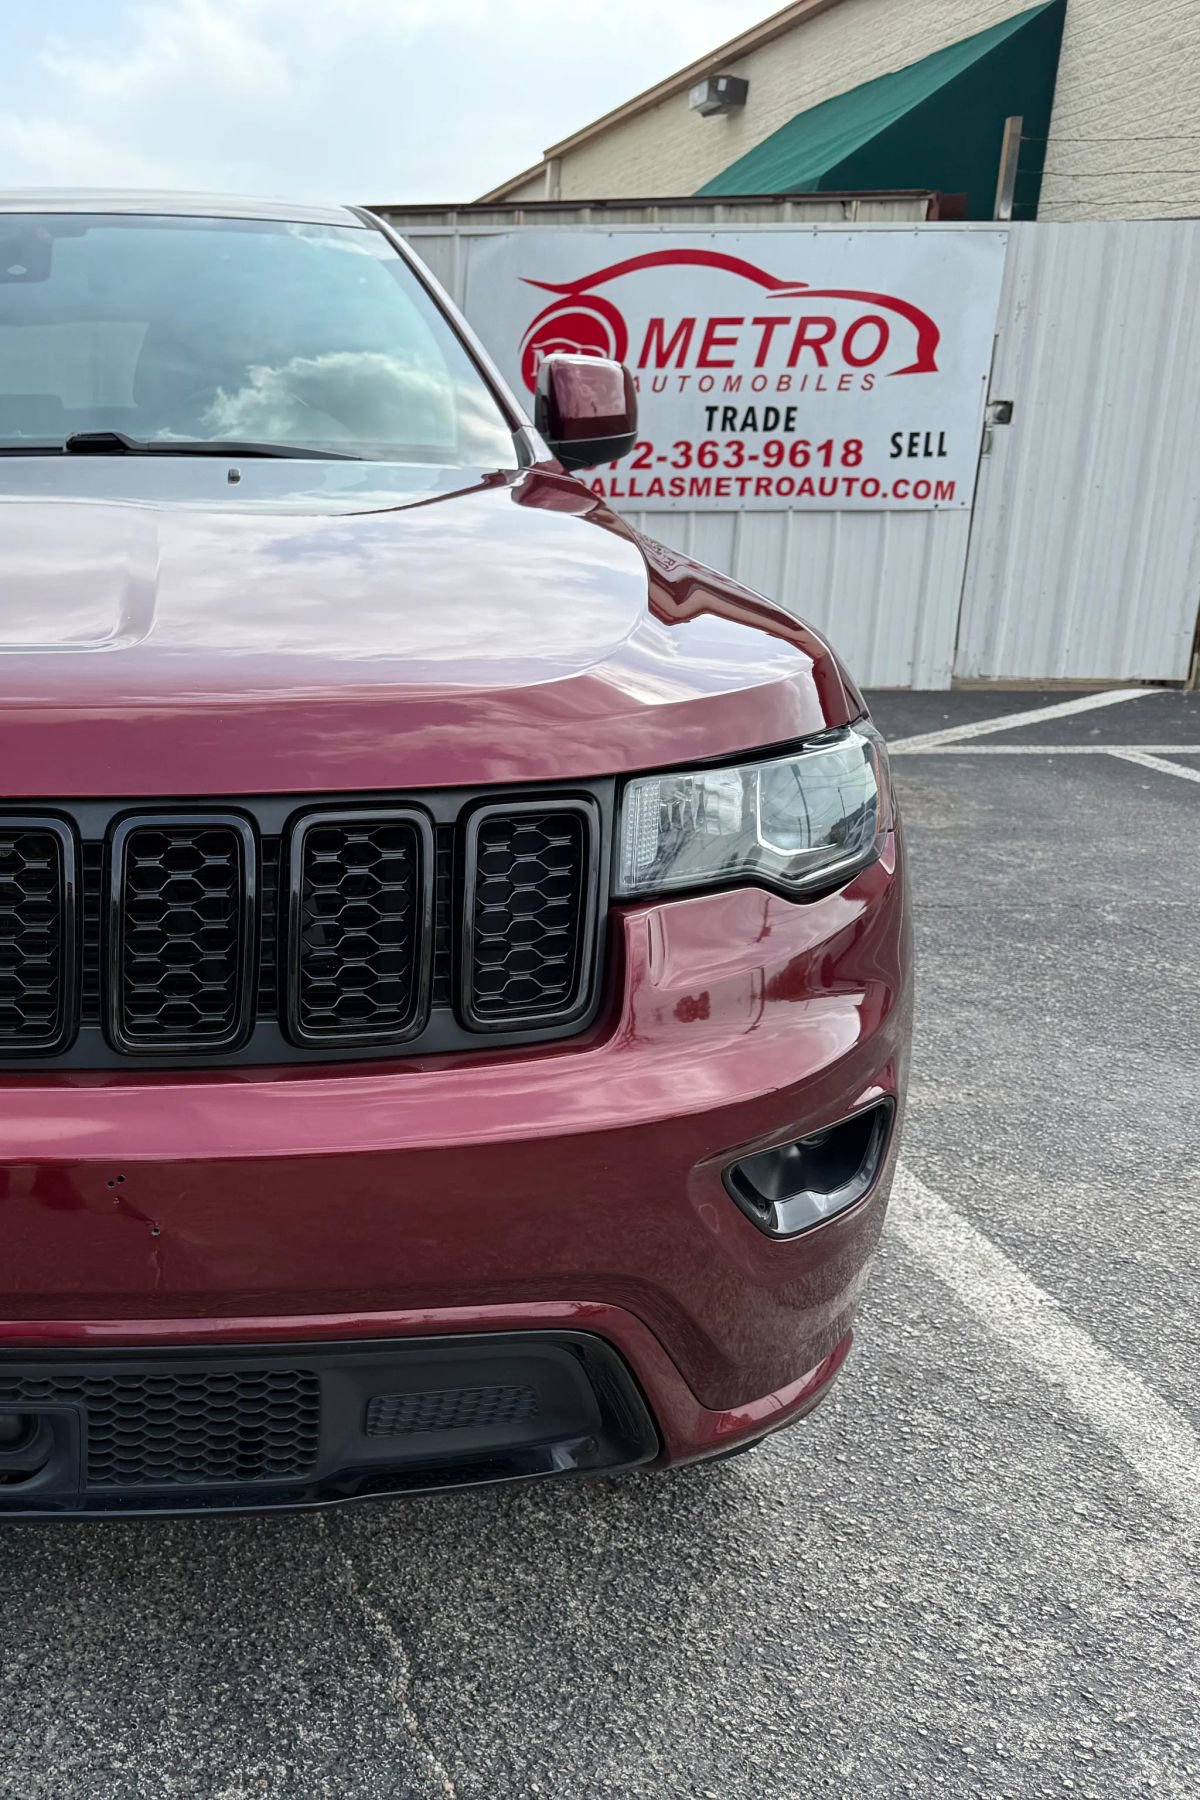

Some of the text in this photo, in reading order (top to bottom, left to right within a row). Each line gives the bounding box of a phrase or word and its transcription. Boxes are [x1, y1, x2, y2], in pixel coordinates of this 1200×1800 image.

[637, 315, 890, 369] METRO
[705, 406, 798, 432] TRADE
[582, 438, 864, 471] 2-363-9618
[890, 431, 947, 458] SELL
[577, 476, 956, 501] ALLASMETROAUTO.COM
